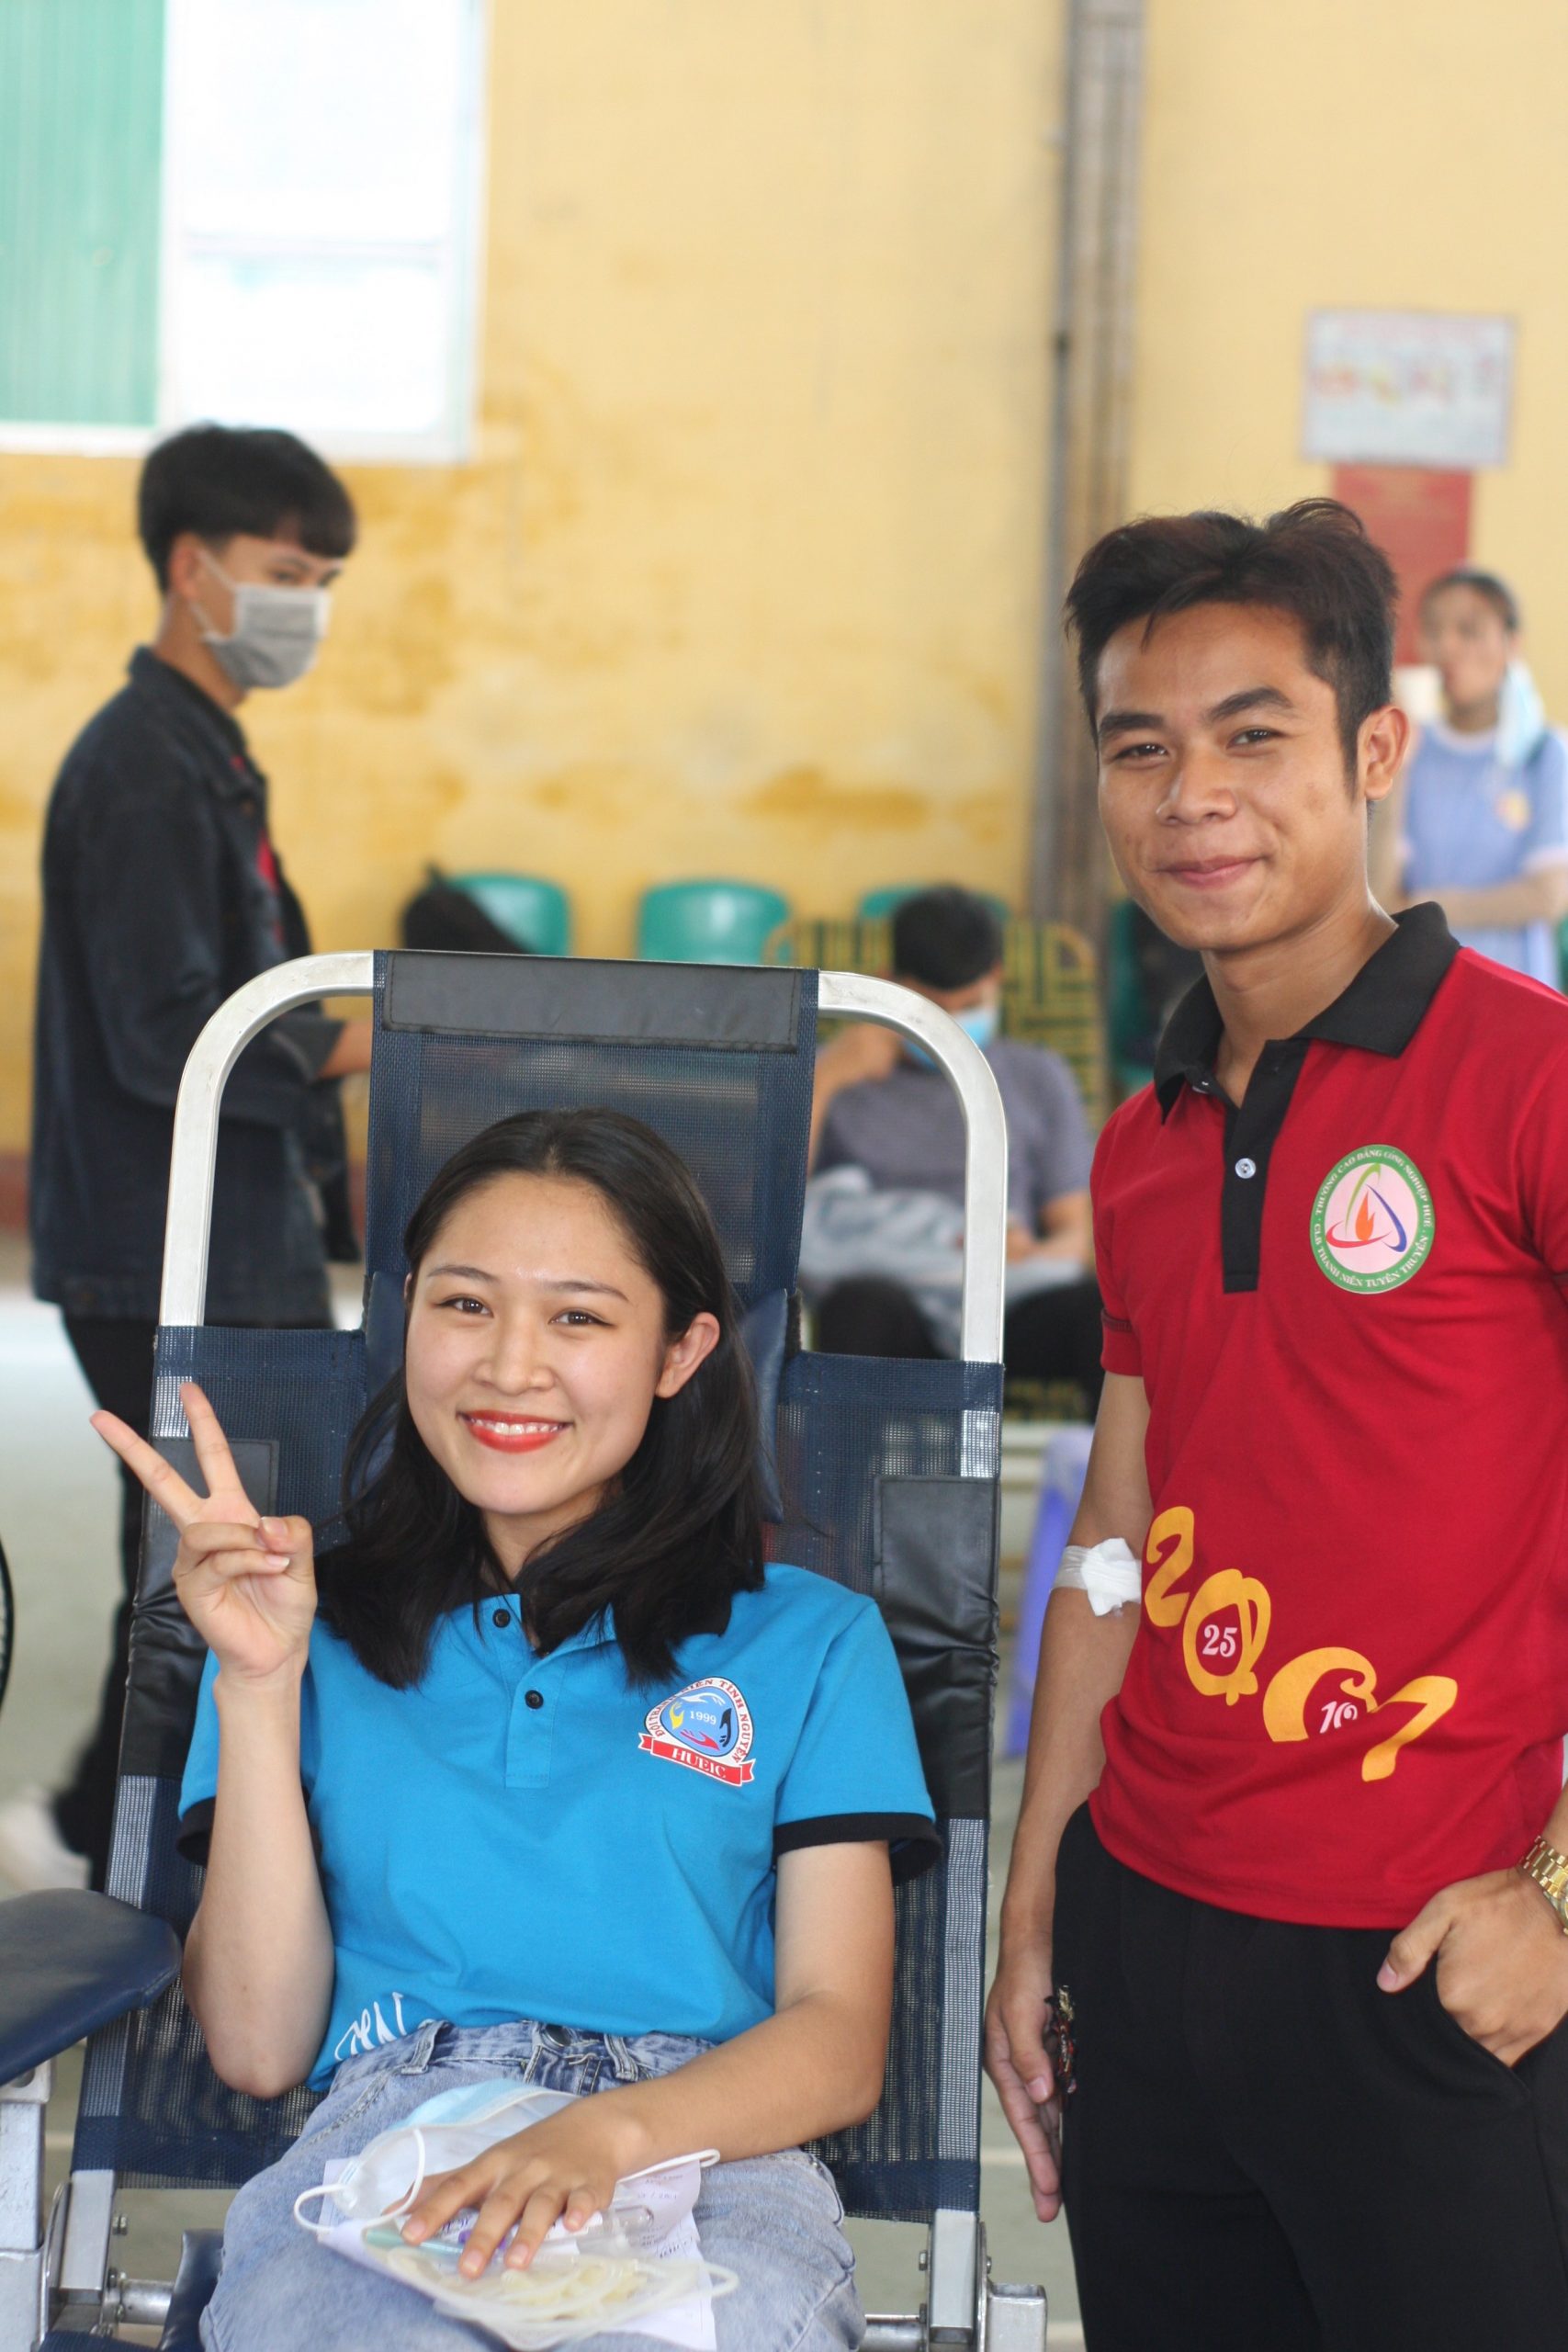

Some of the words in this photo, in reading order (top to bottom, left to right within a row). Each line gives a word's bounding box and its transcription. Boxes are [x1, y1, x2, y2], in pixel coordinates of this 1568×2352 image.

[1202, 1624, 1237, 1657] 25
[690, 1711, 717, 1725] 1999
[671, 1747, 727, 1779] HUEIC
